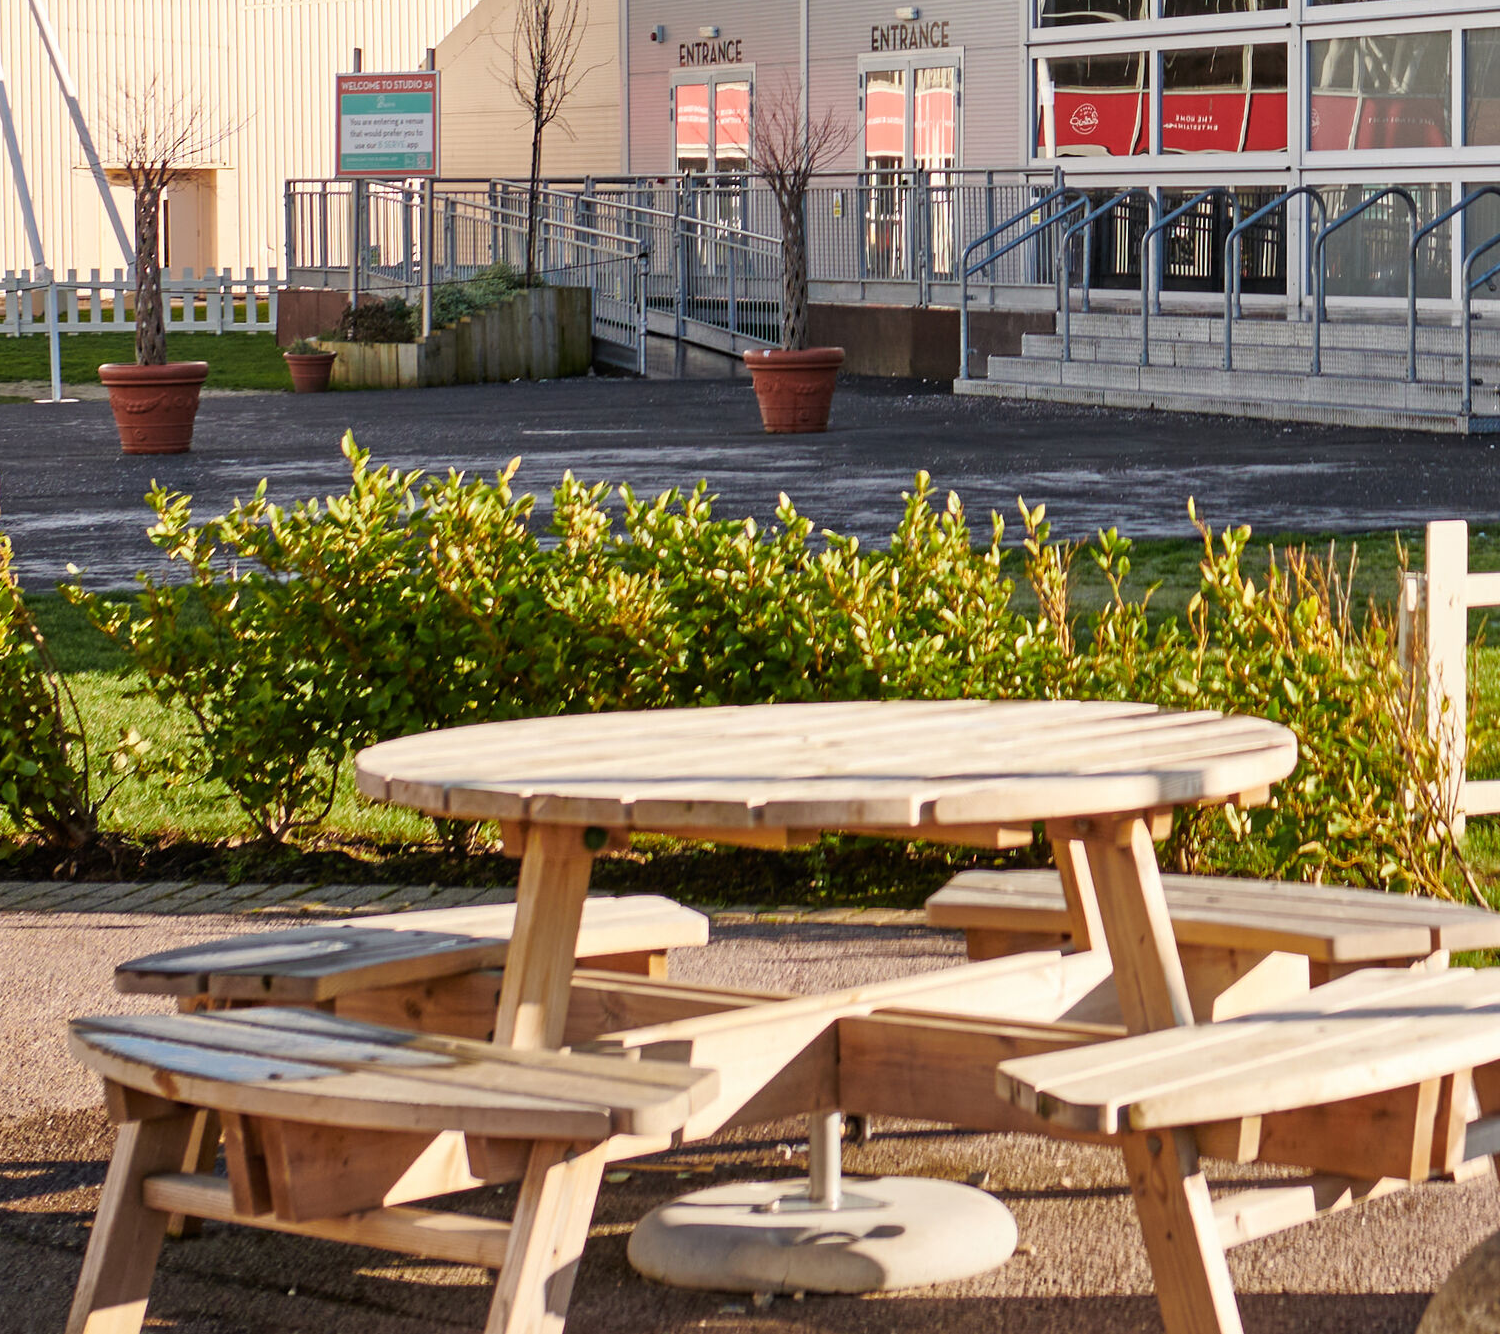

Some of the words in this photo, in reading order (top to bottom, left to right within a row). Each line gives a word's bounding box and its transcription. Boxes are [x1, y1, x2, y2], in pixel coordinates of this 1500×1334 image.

[870, 20, 951, 52] ENTRANCE
[679, 38, 743, 66] ENTRANCE
[342, 80, 381, 90] WELCOME
[382, 80, 392, 90] TO
[393, 79, 423, 90] STUDIO
[373, 118, 398, 126] entering
[364, 129, 382, 137] would
[383, 128, 402, 138] prefer
[404, 130, 415, 138] you
[406, 142, 419, 150] app
